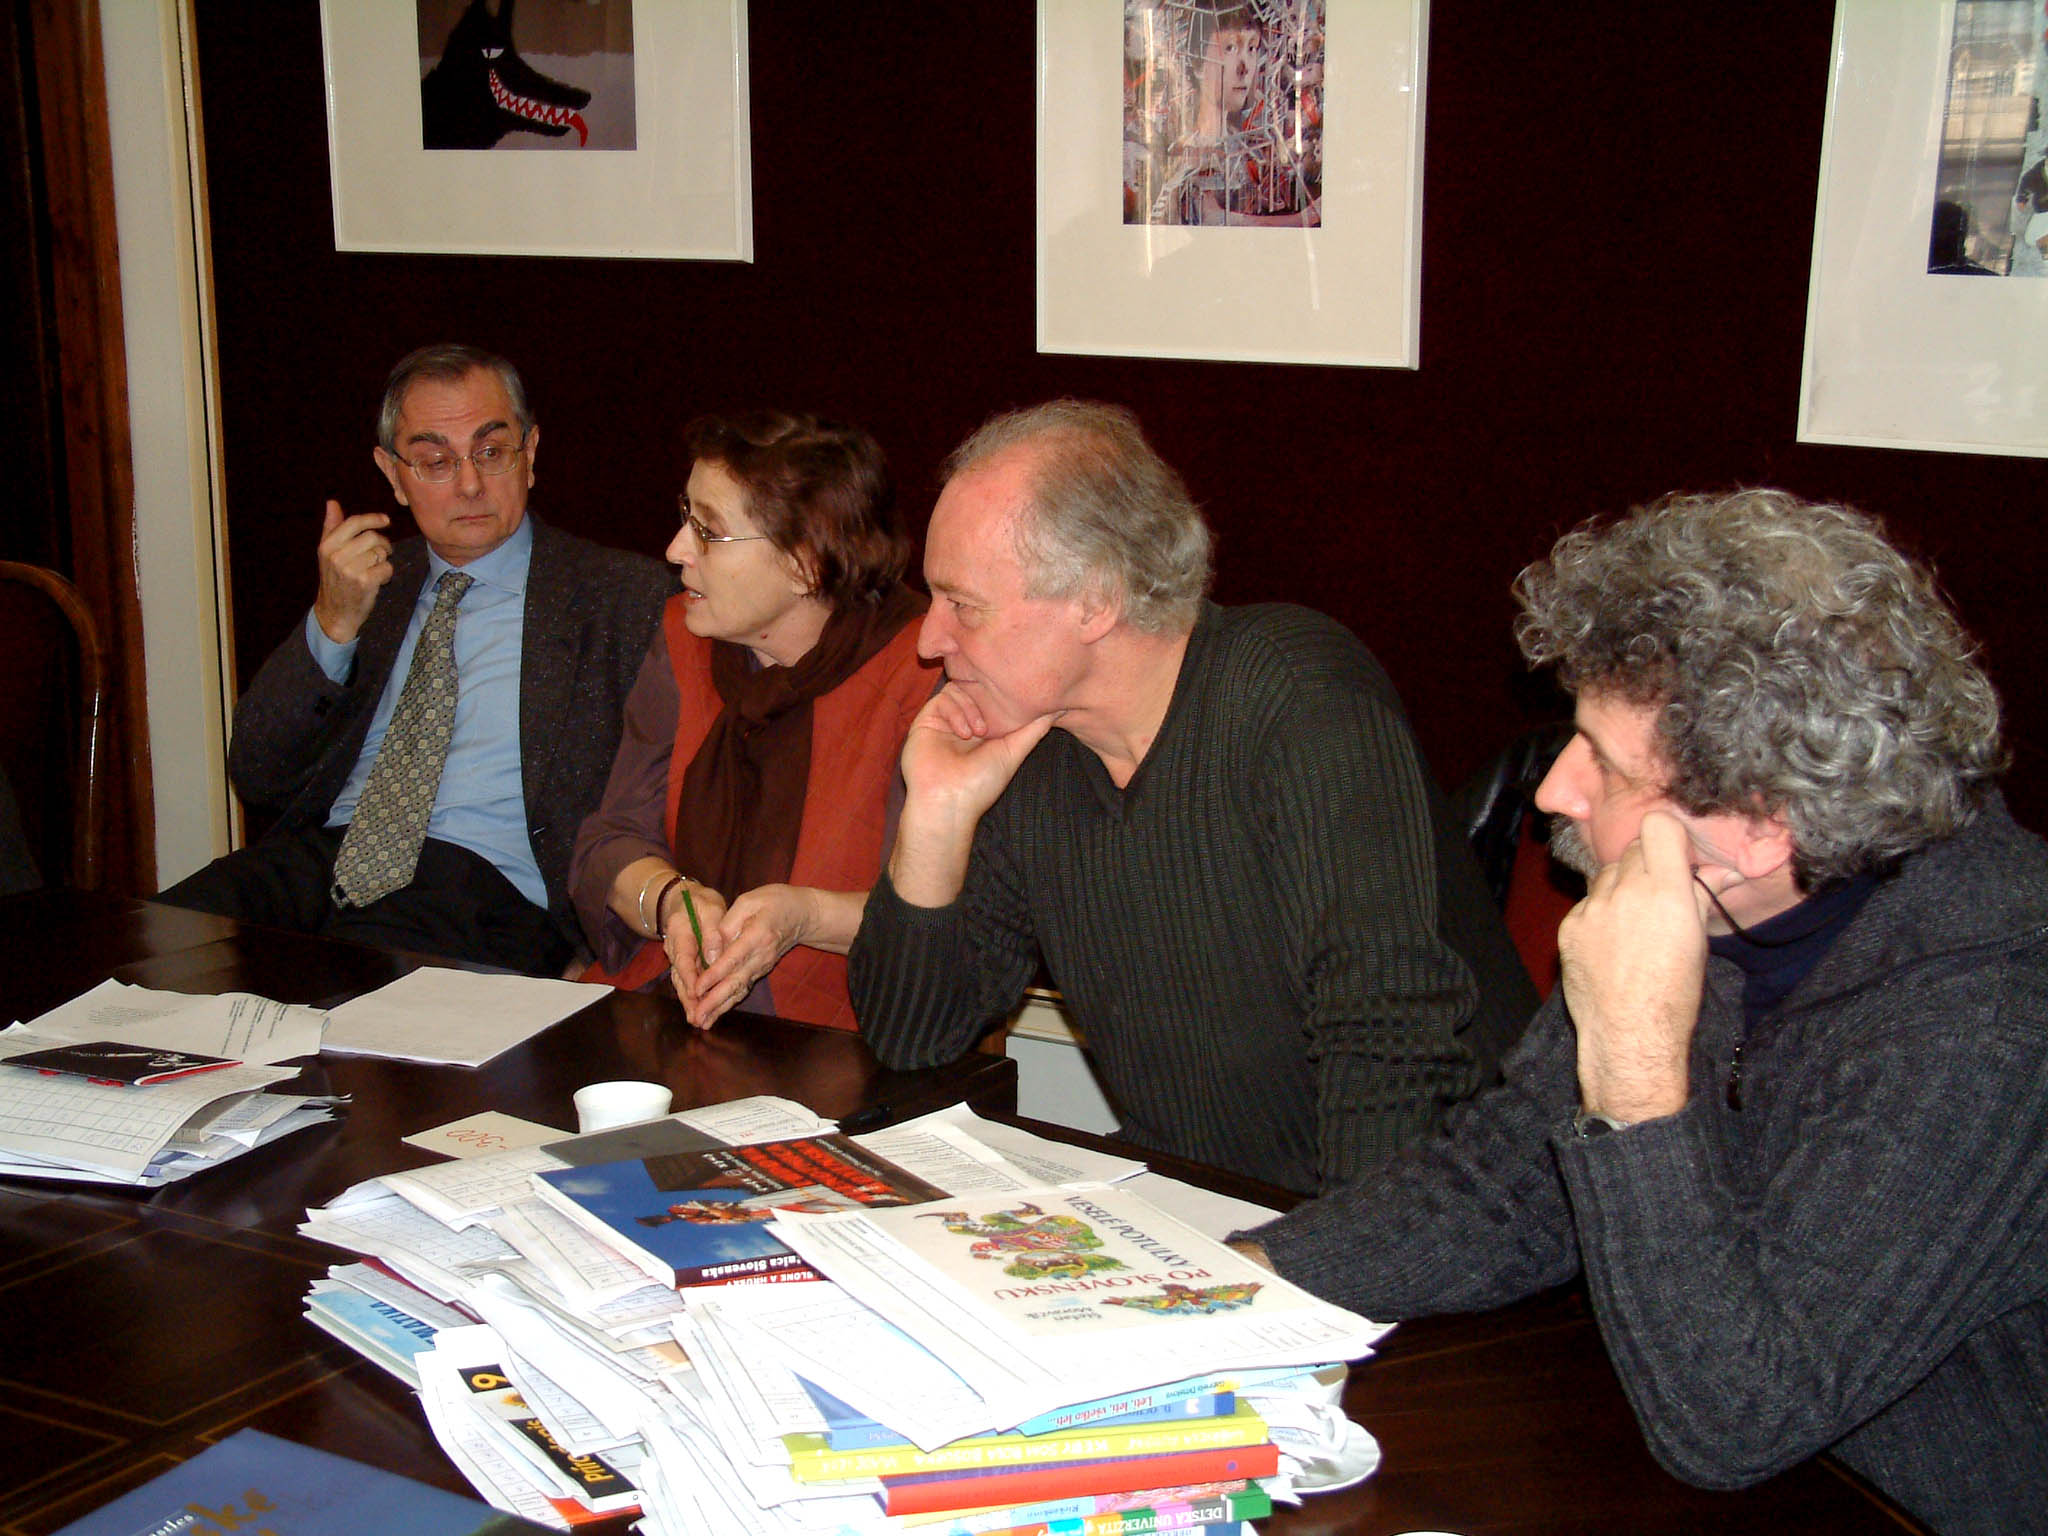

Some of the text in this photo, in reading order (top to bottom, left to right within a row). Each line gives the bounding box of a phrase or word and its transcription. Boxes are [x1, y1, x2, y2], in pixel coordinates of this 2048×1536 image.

[701, 1259, 768, 1278] Slovenska
[993, 1268, 1213, 1300] PO SLOVENSKU
